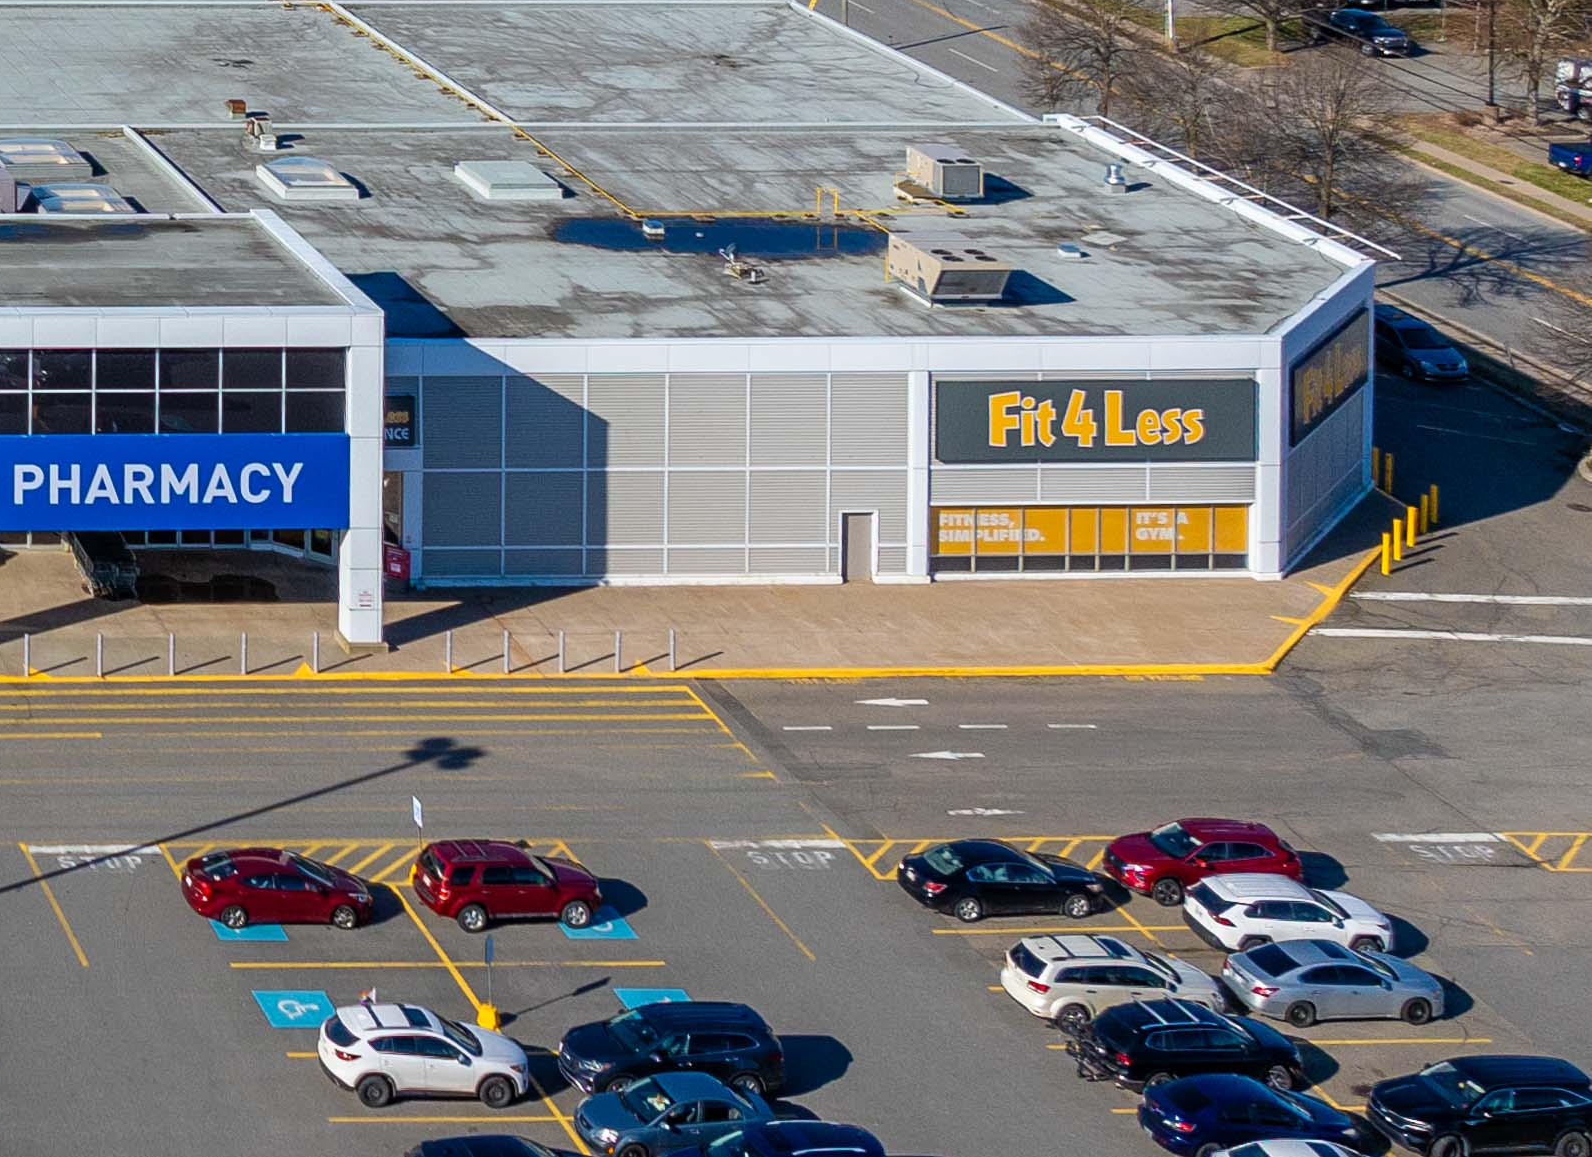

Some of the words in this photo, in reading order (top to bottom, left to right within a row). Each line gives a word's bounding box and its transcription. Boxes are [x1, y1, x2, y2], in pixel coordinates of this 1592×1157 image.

[988, 390, 1057, 447] Fit
[1061, 389, 1097, 447] 4
[1103, 390, 1205, 446] Less
[13, 462, 304, 505] PHARMACY
[938, 513, 1015, 528] FITNESS,
[1136, 511, 1167, 524] IT'S
[748, 850, 834, 870] STOP
[1409, 844, 1496, 861] STOP
[56, 856, 142, 871] STOP
